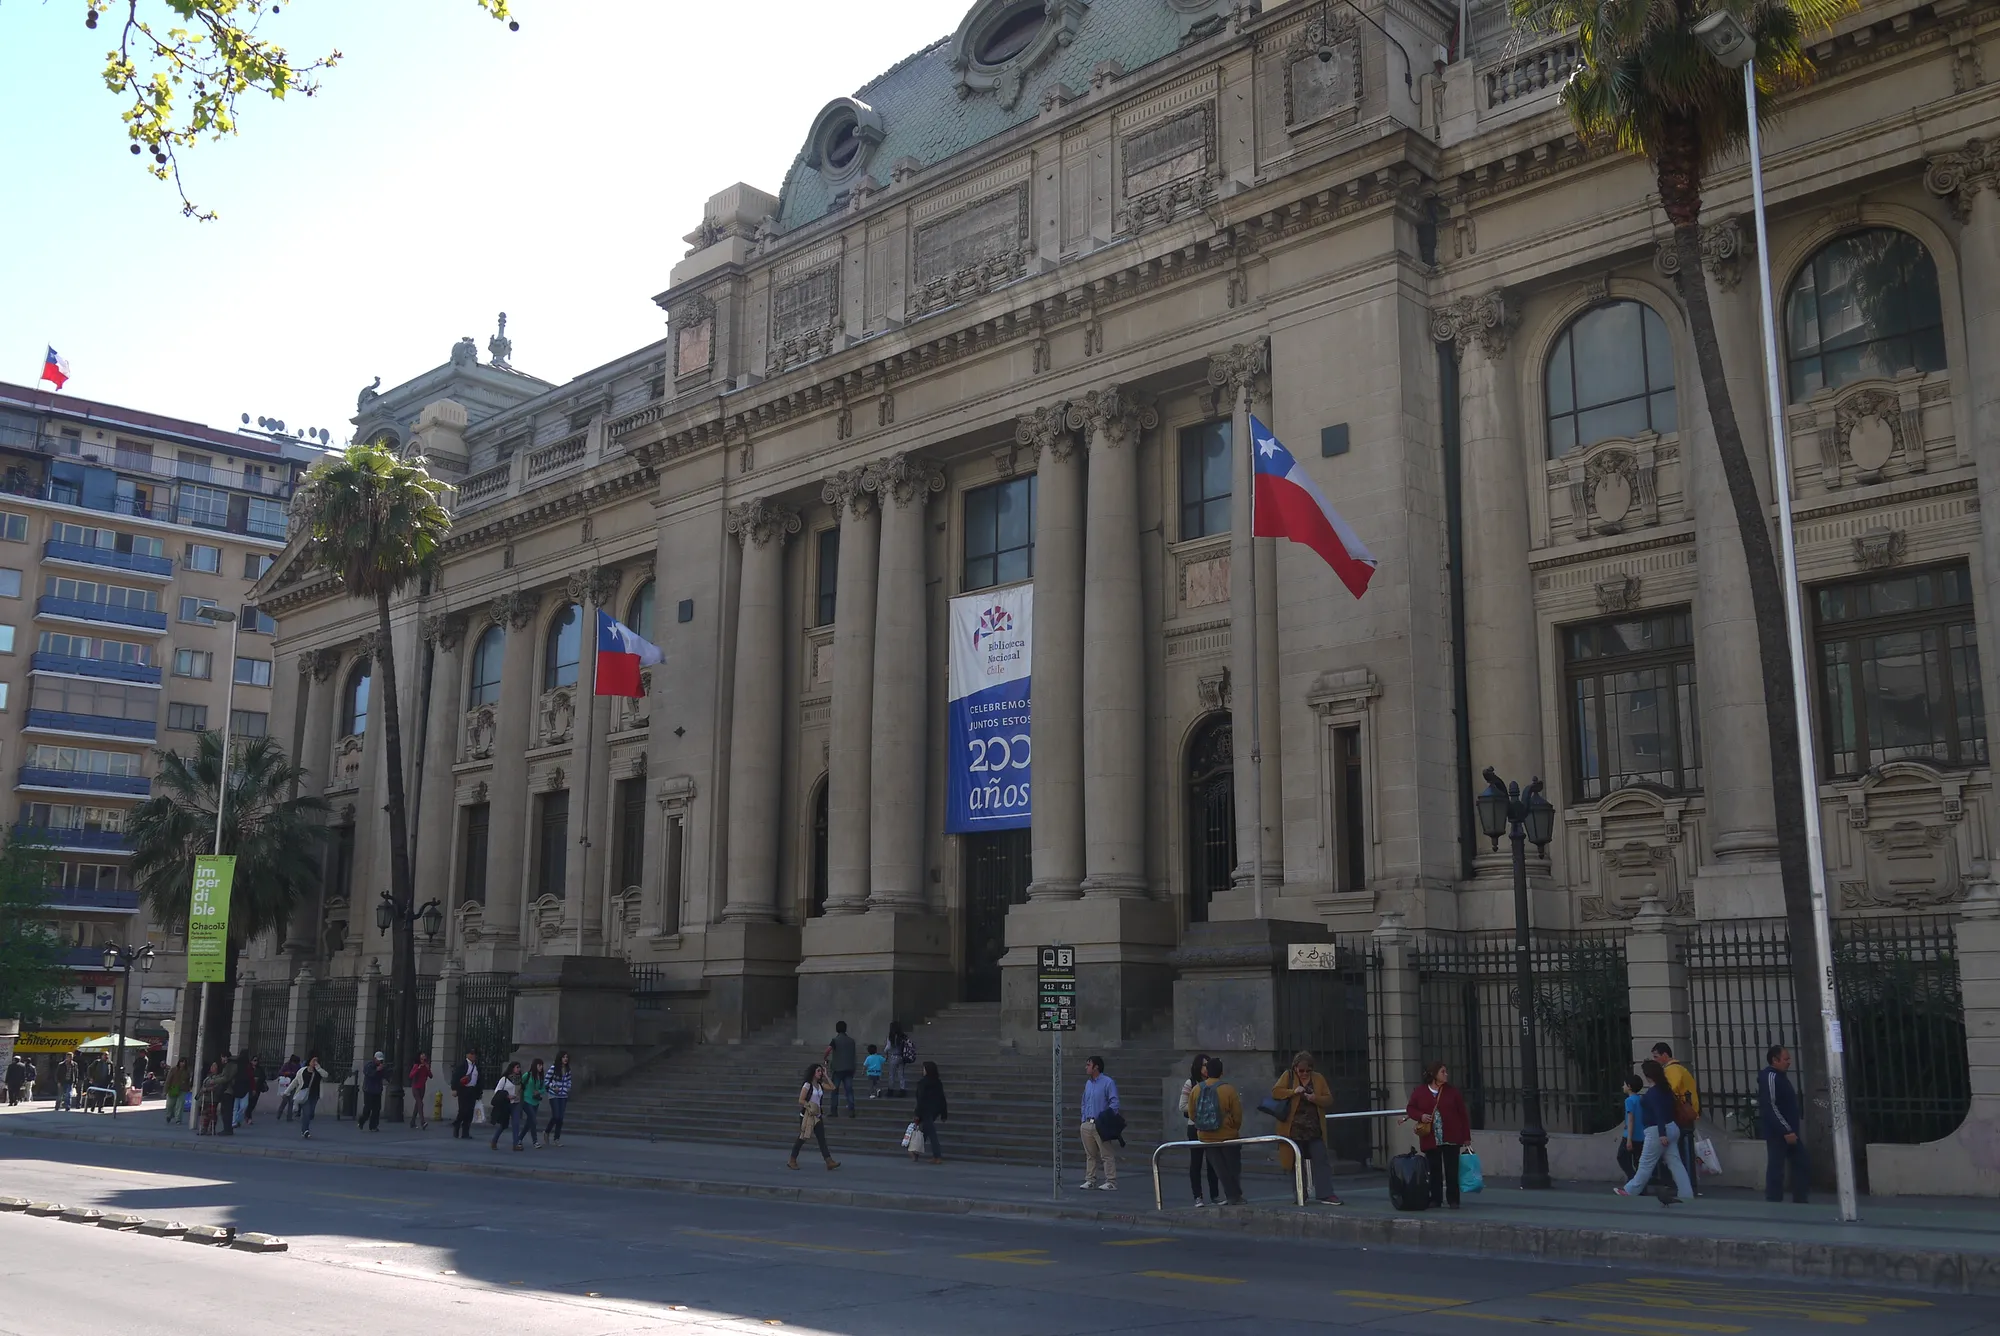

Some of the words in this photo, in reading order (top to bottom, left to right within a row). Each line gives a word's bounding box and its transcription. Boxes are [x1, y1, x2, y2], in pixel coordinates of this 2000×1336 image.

[969, 698, 1031, 714] CELEBREMOS
[969, 718, 999, 731] JUNTOS
[1002, 715, 1031, 726] ESTOS
[969, 777, 1030, 811] años
[197, 864, 216, 878] im
[195, 878, 221, 891] per
[194, 888, 210, 902] di
[193, 902, 216, 915] ble
[191, 922, 226, 930] Chaco13
[1062, 954, 1068, 964] 3
